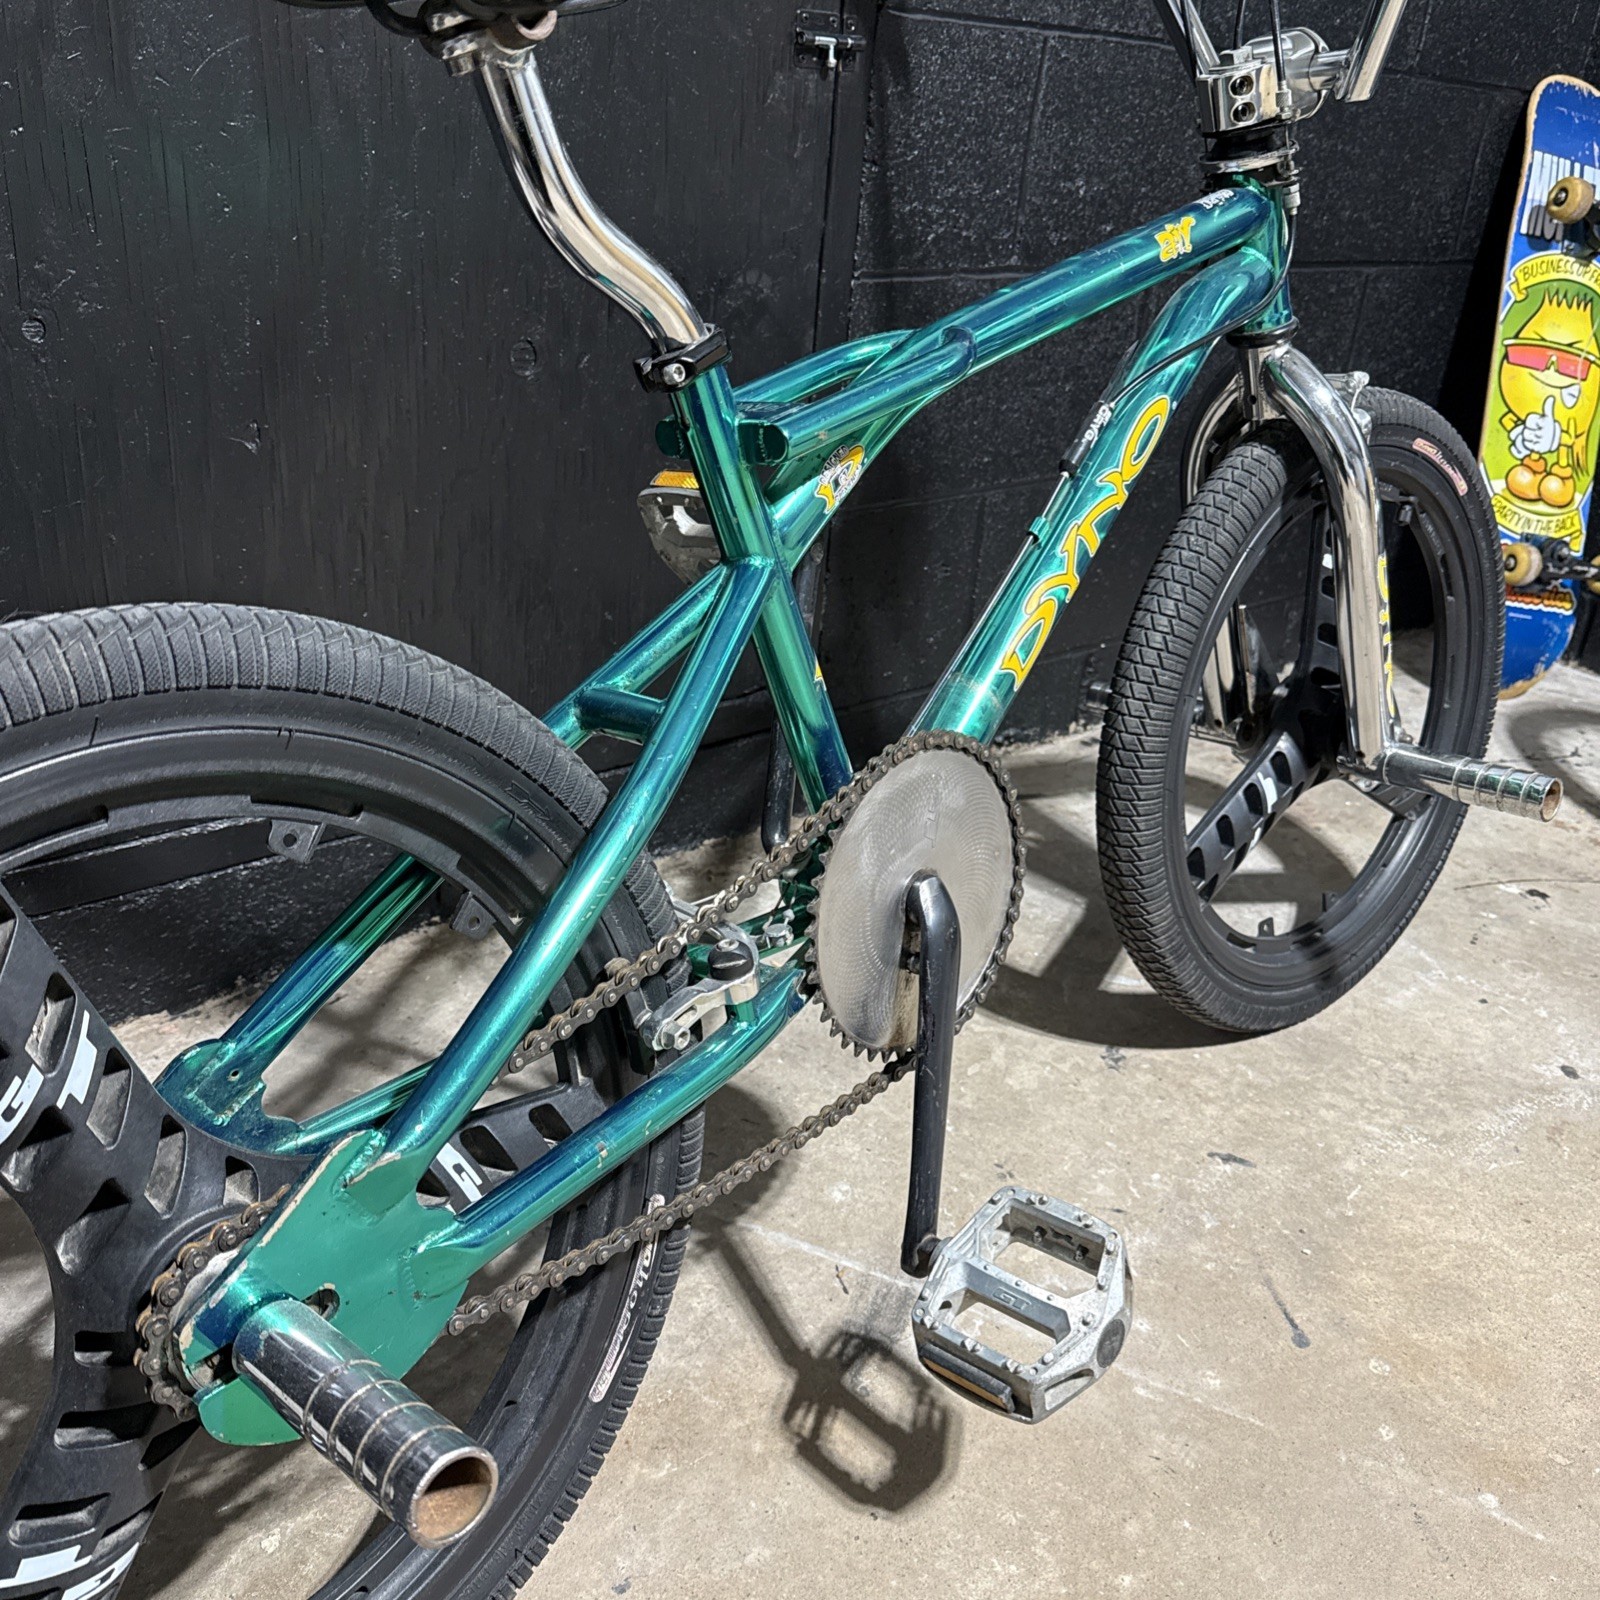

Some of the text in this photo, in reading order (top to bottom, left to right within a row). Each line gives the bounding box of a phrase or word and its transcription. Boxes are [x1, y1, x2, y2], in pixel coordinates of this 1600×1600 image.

[1000, 395, 1170, 691] DYNO
[1521, 516, 1532, 529] IN
[1534, 519, 1553, 531] THE
